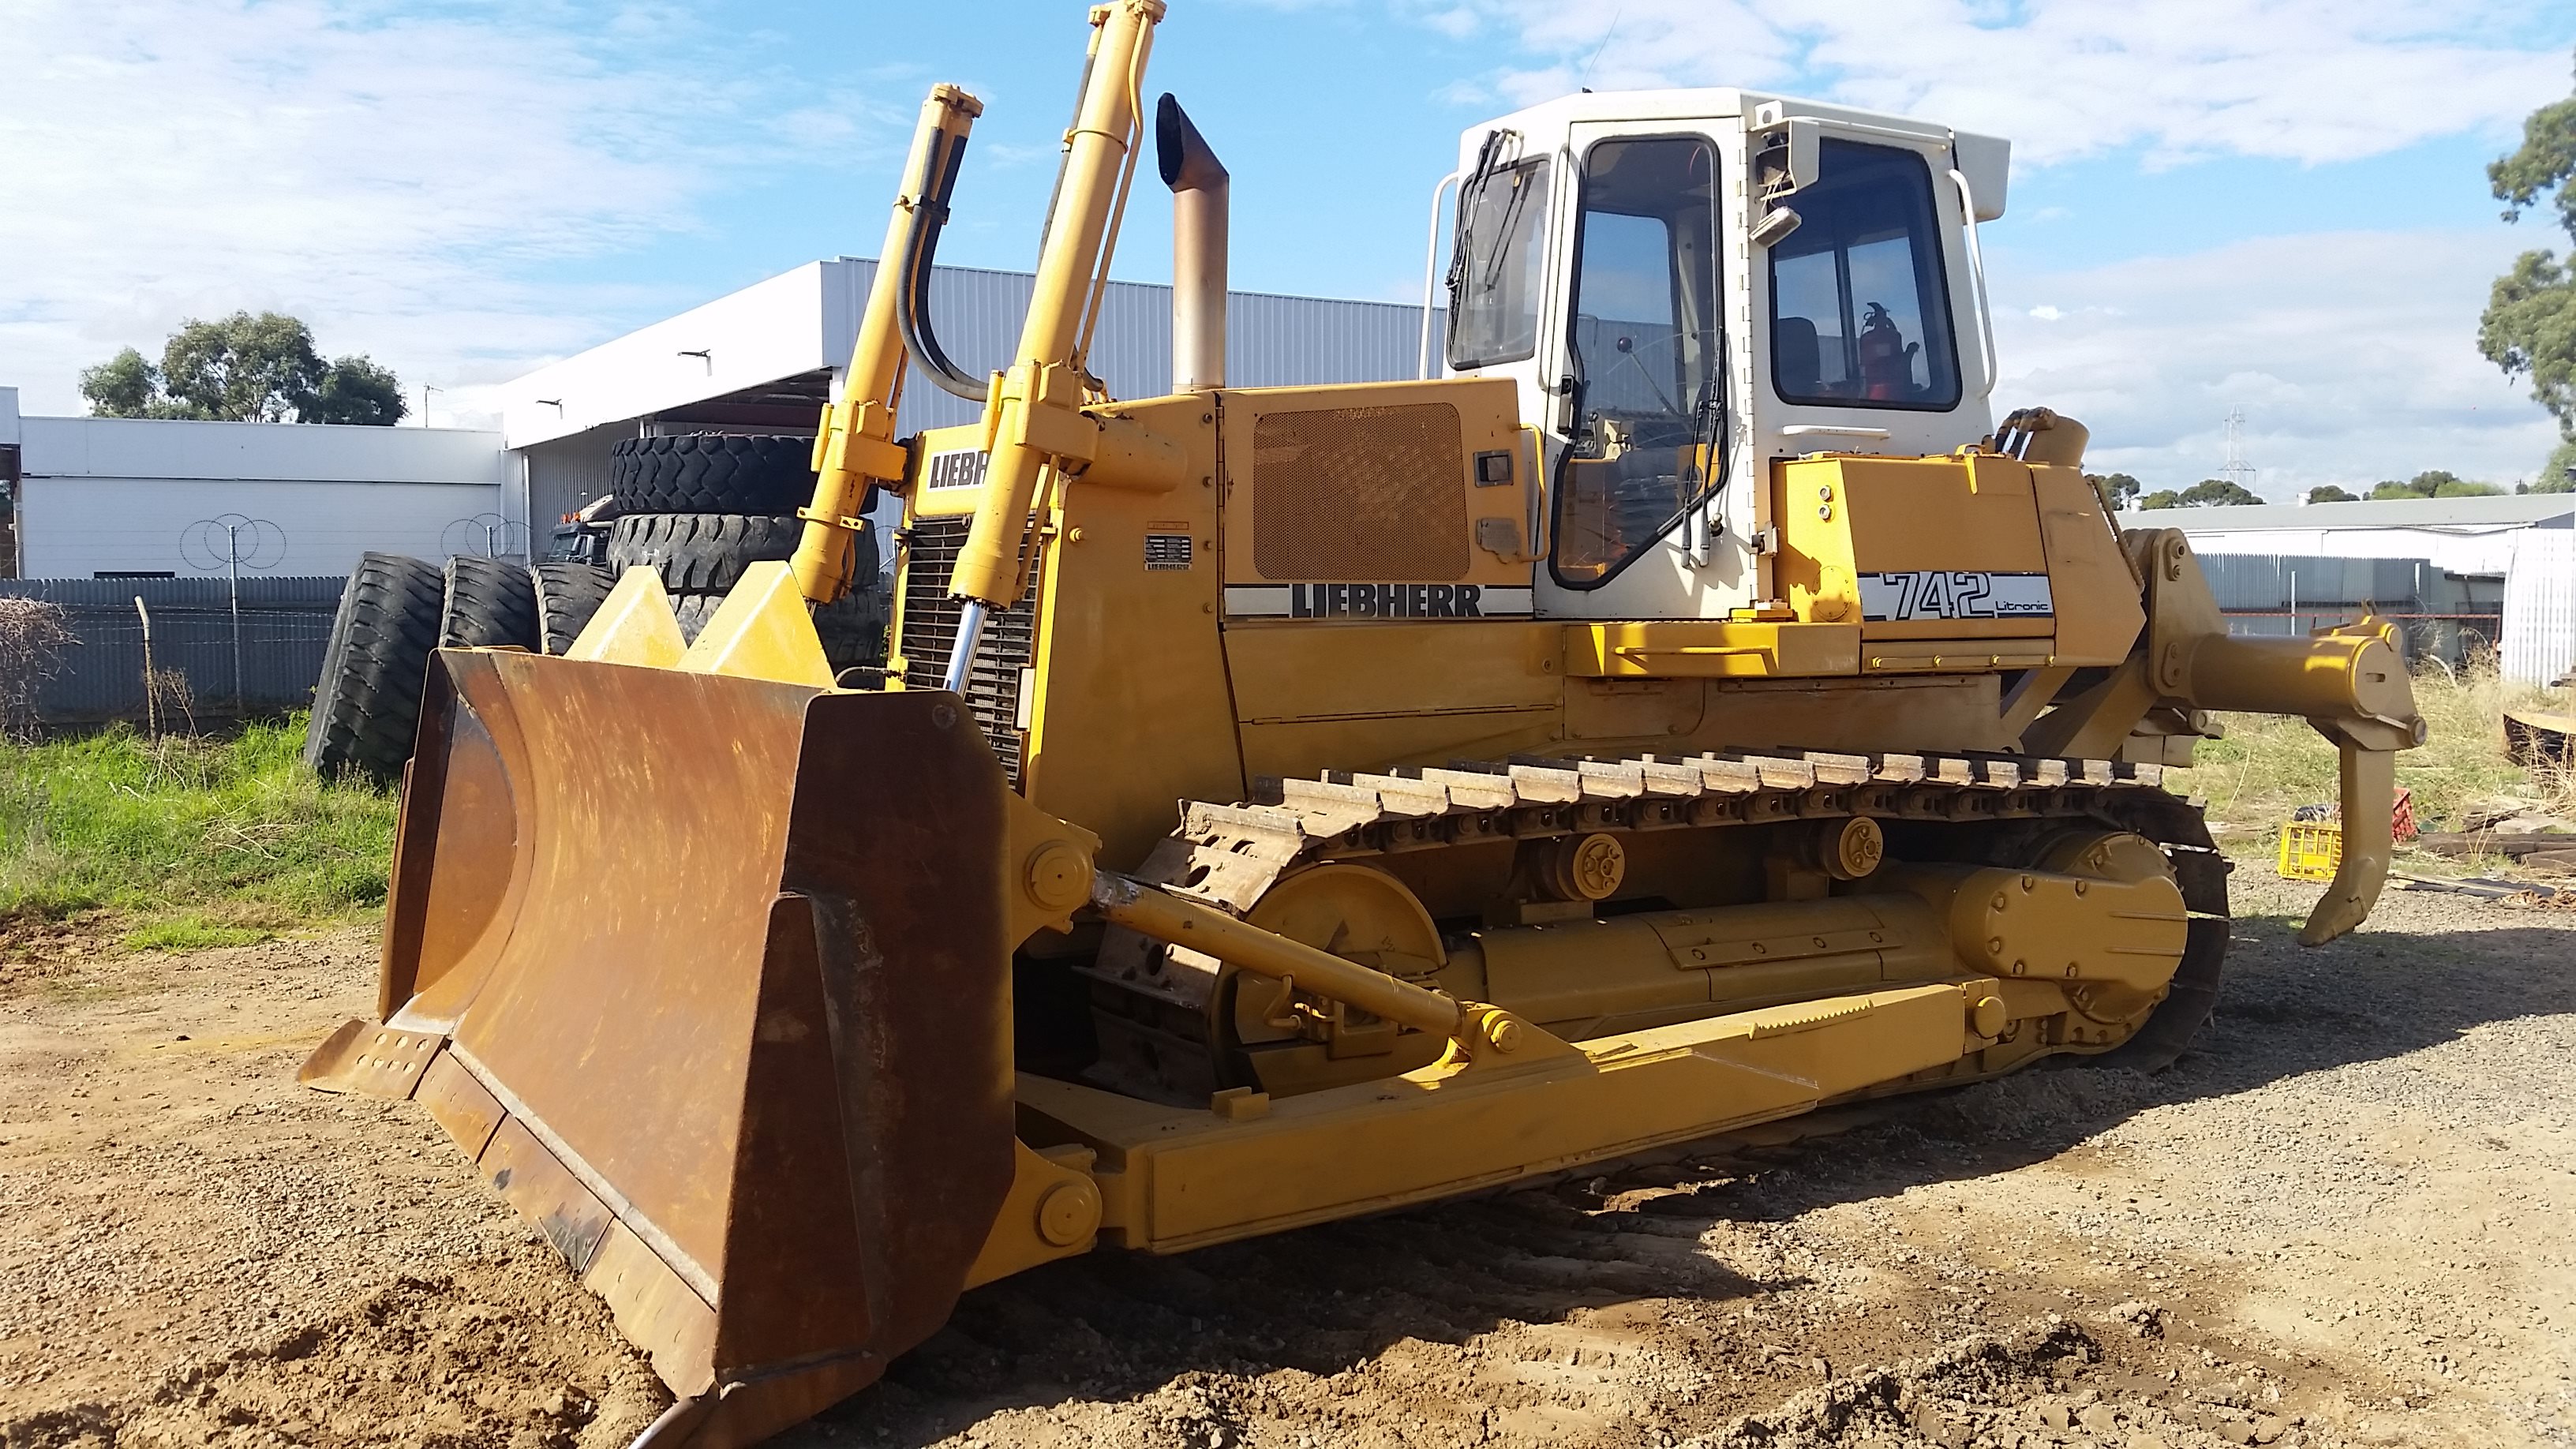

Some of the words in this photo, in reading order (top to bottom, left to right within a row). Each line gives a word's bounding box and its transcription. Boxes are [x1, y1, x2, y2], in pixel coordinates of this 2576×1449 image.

[929, 451, 990, 489] LIEBH
[1292, 584, 1481, 618] LIEBHERR
[1883, 571, 1995, 620] 742
[1995, 601, 2049, 611] Litronic
